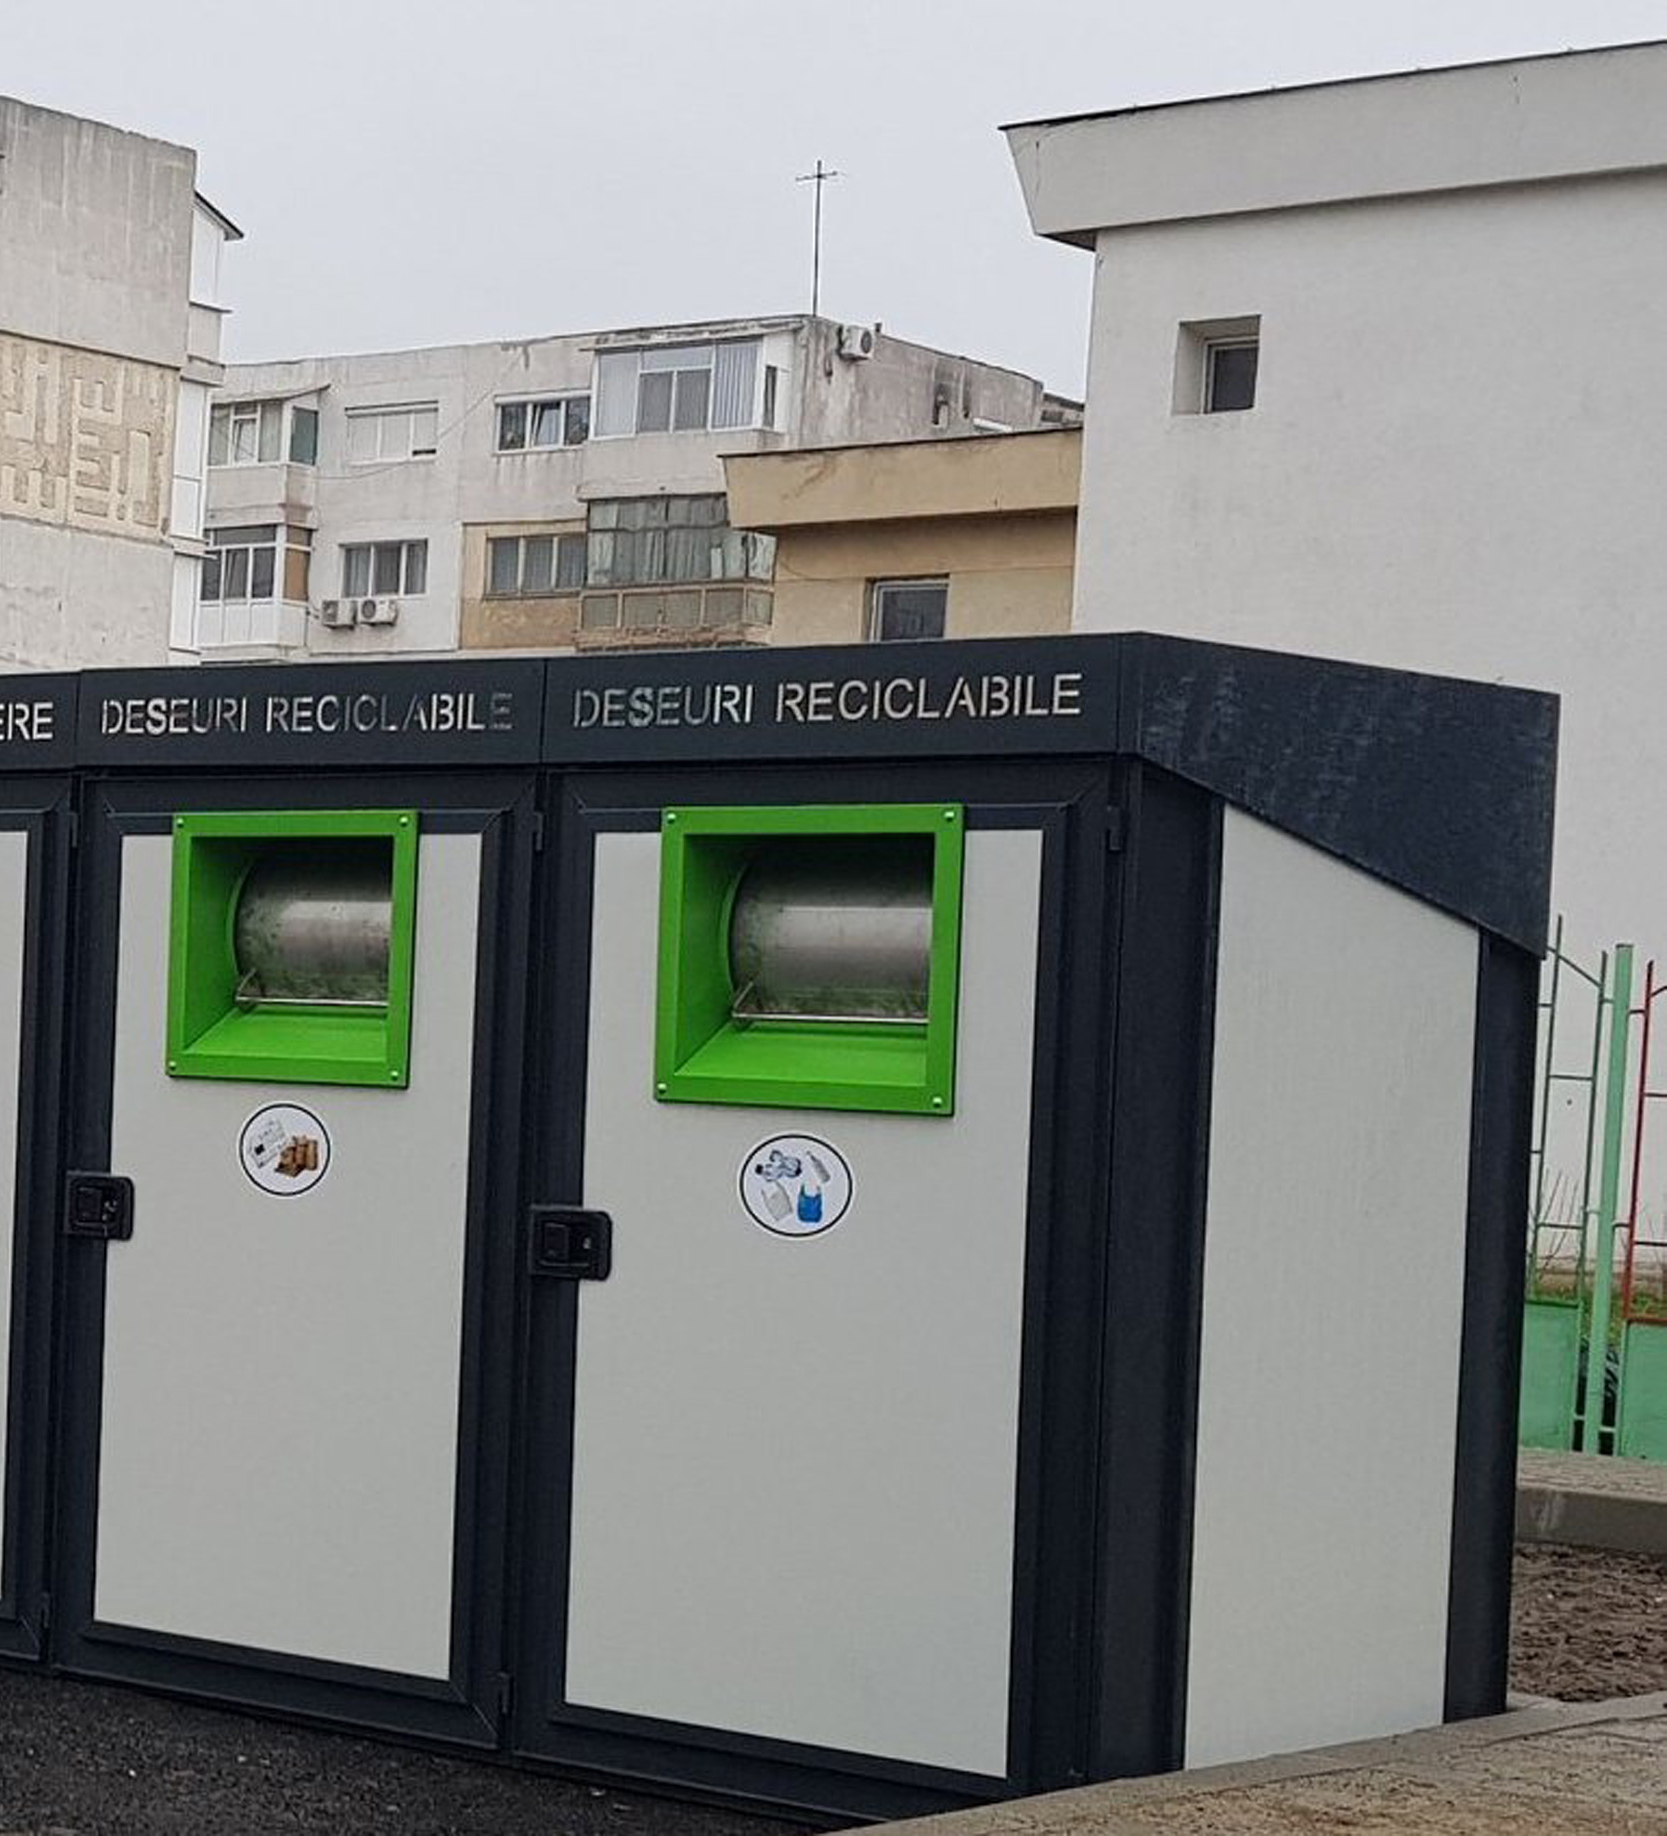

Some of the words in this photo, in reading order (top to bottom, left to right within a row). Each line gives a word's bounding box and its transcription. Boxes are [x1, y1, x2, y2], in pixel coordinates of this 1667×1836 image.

[101, 697, 247, 735] DESEURI
[266, 692, 514, 733] RECICLABILE
[572, 684, 754, 728] DESEURI
[775, 673, 1083, 722] RECICLABILE
